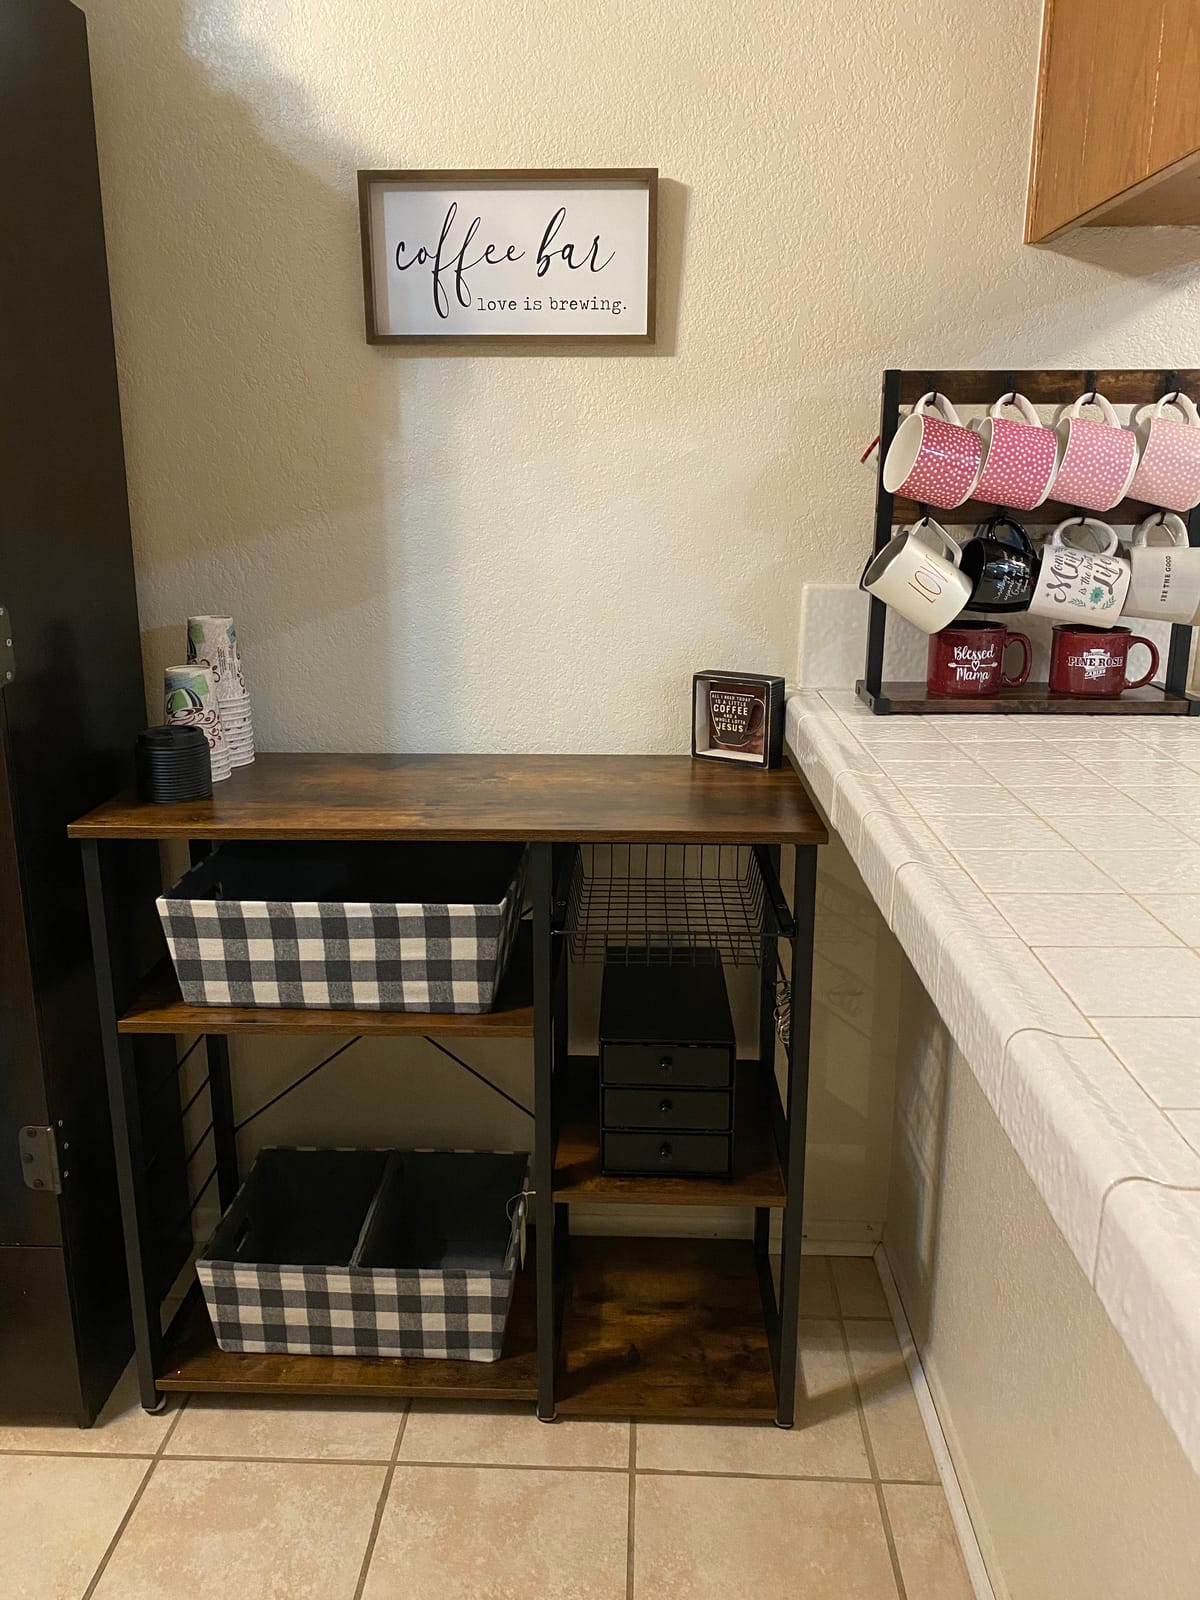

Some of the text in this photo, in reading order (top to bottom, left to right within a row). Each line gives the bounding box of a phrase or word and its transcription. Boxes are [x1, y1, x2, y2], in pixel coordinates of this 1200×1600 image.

[396, 201, 616, 318] coffee bar
[477, 297, 627, 315] love is brewing.
[1046, 552, 1079, 603] Mom
[1081, 571, 1092, 585] the
[1092, 558, 1123, 595] Life
[1162, 573, 1171, 589] THE
[954, 643, 995, 660] Blessed
[1068, 656, 1123, 668] PINE ROSE
[956, 667, 990, 683] Mama
[713, 704, 748, 715] COFFEE
[716, 722, 744, 733] JESUS
